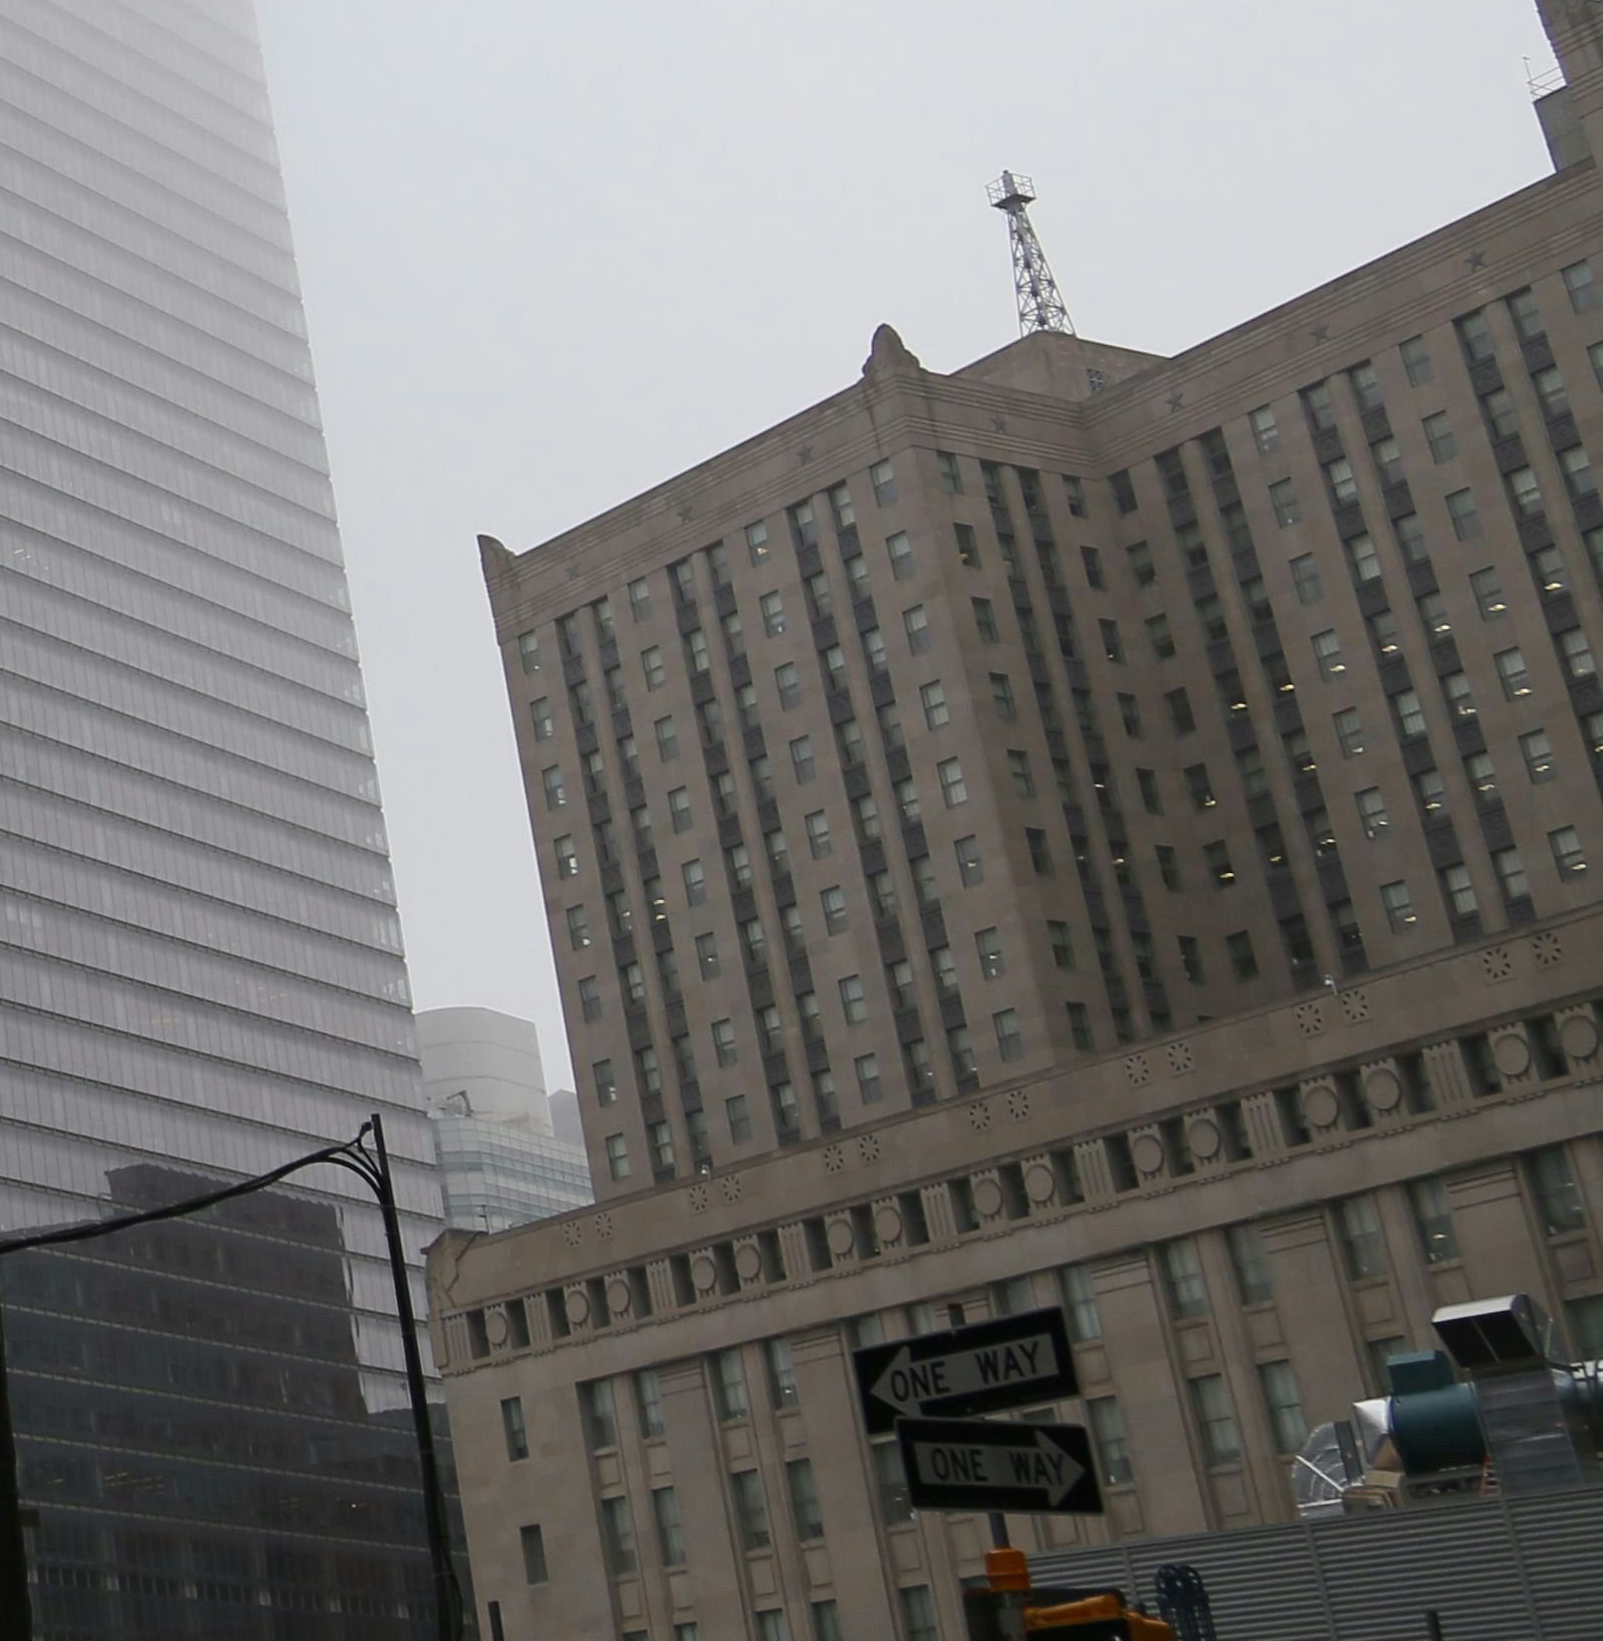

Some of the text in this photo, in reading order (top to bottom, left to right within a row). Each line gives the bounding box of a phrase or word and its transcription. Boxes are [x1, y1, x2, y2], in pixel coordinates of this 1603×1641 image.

[891, 1342, 1039, 1402] ONE WAY
[932, 1448, 1064, 1485] ONE WAY
